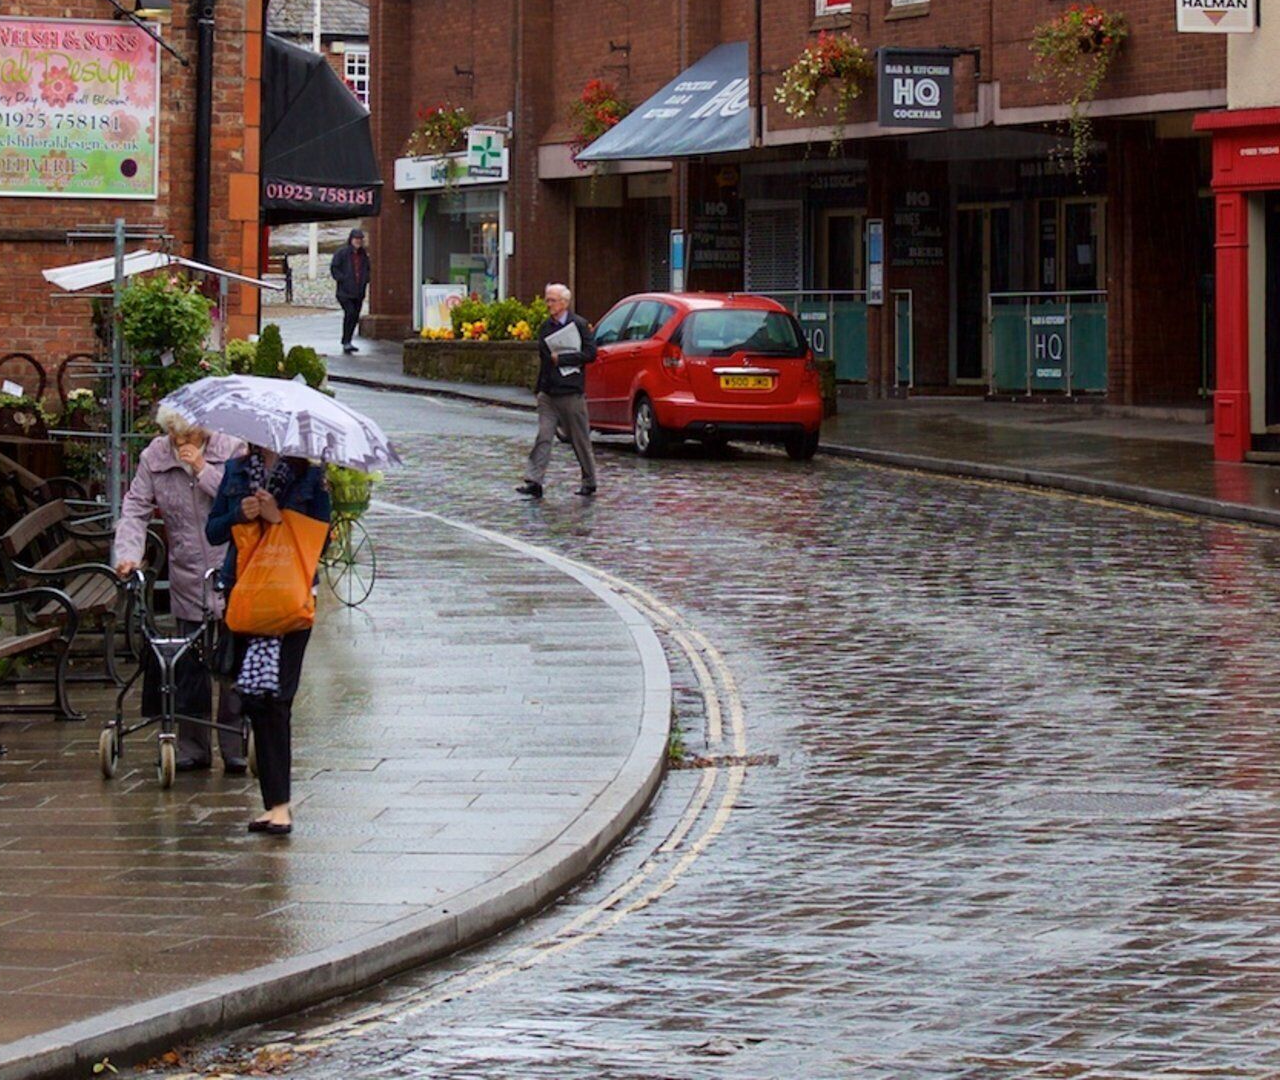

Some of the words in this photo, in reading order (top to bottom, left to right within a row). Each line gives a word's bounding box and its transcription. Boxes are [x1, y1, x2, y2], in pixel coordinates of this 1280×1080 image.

[62, 30, 80, 50] &
[83, 31, 139, 53] SONS
[34, 51, 136, 94] Design
[885, 65, 903, 74] BAR
[913, 66, 950, 76] KITCHEN
[15, 92, 38, 107] Day
[893, 78, 940, 106] HQ
[55, 113, 120, 131] 758181
[893, 109, 942, 119] COCKTAILS
[267, 184, 313, 200] 01925
[318, 187, 375, 205] 758181
[1035, 333, 1062, 360] HQ
